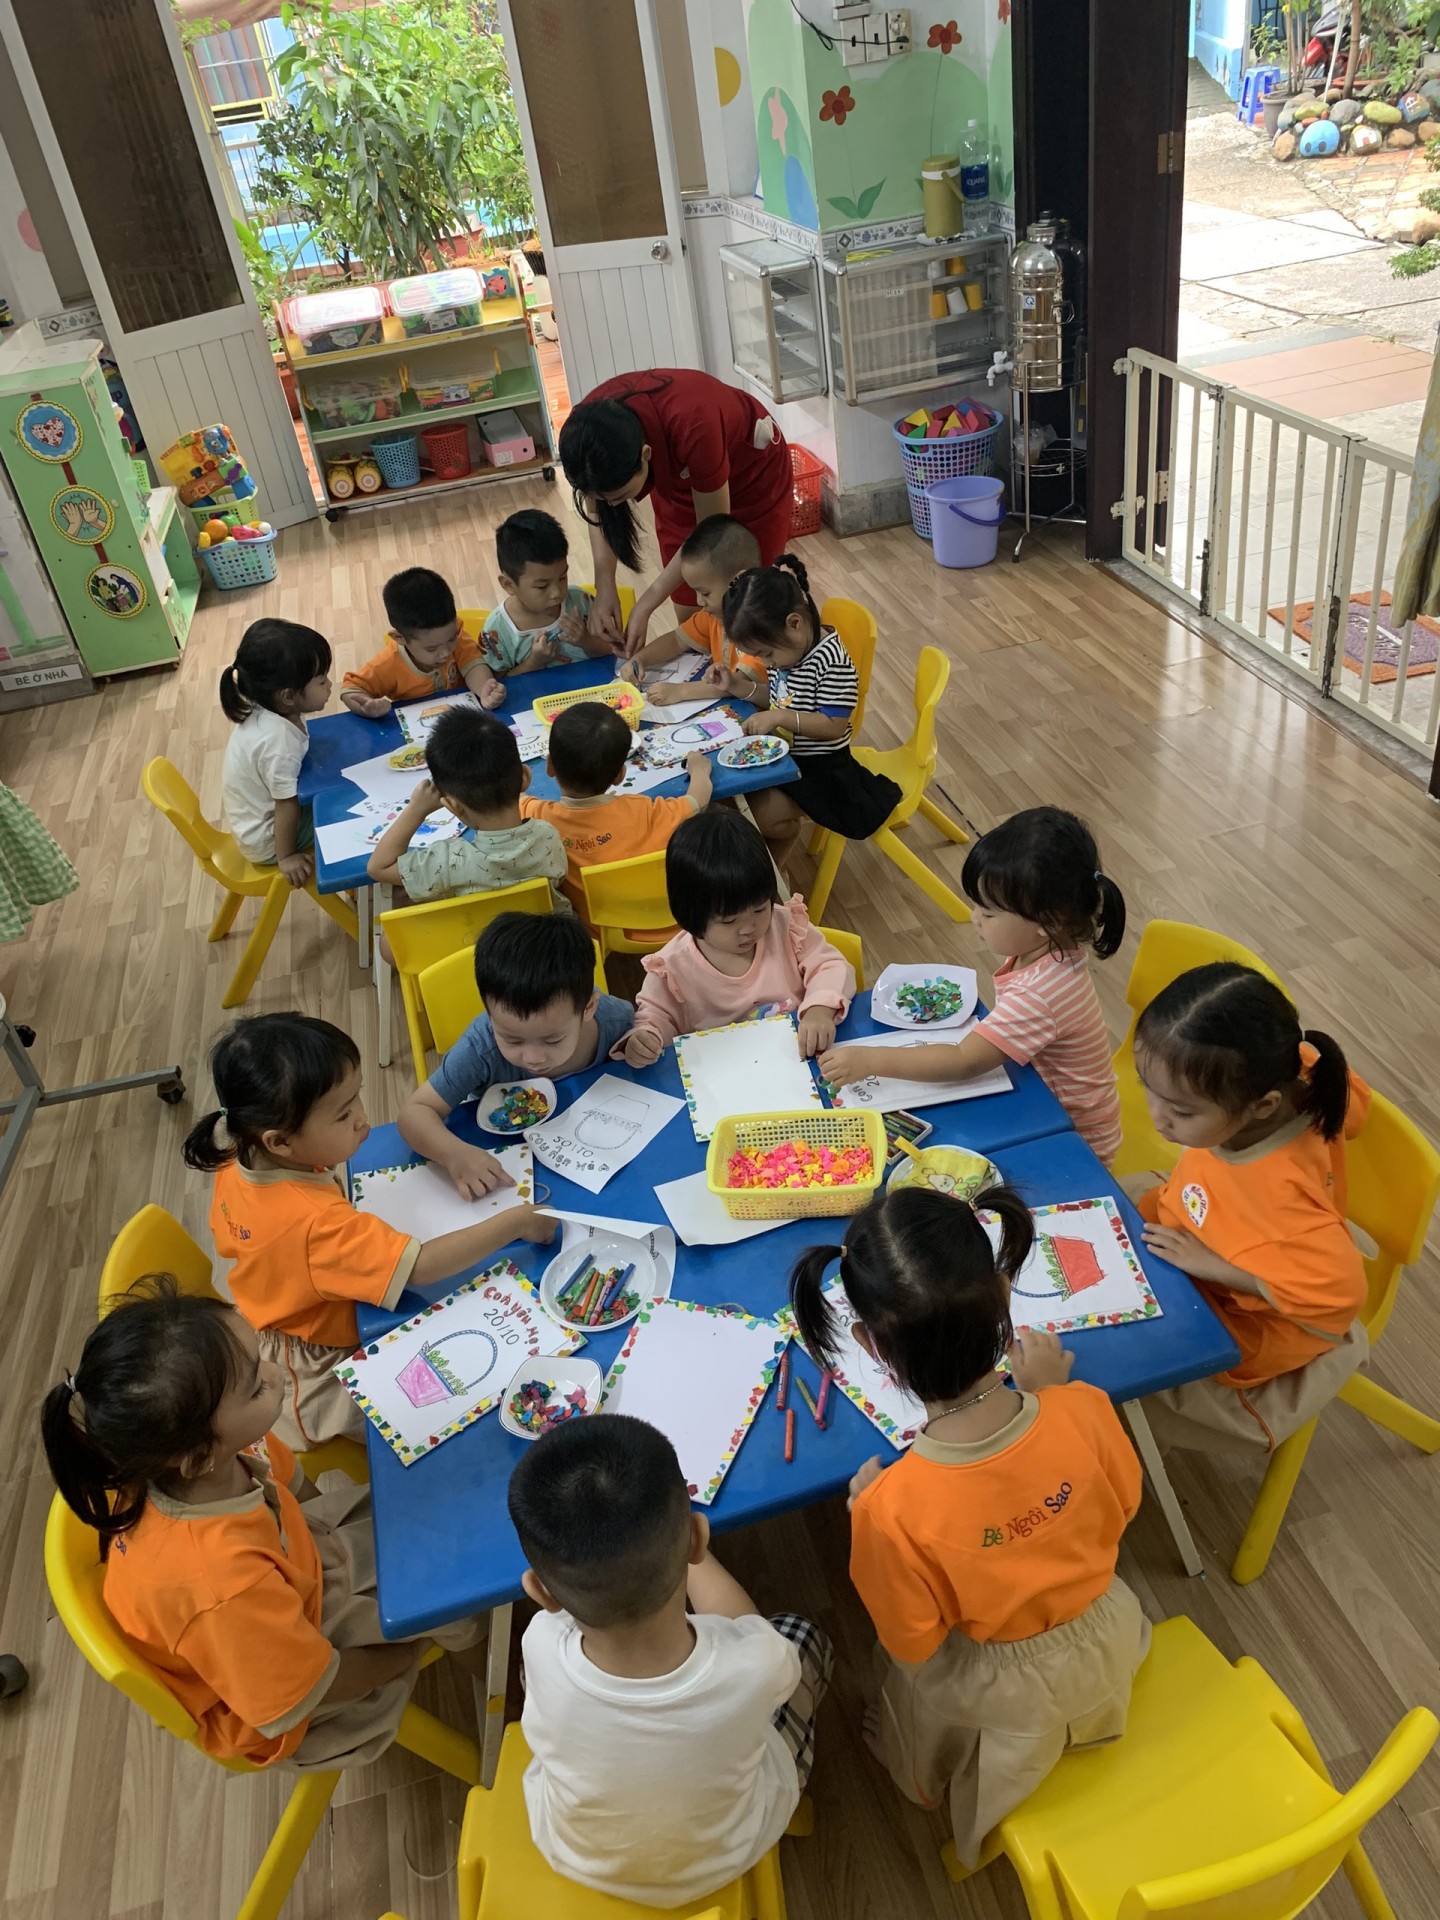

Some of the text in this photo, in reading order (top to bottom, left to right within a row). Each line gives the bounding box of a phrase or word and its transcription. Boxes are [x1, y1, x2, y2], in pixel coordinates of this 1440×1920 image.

[15, 675, 31, 686] BÉ
[44, 669, 69, 681] NHÀ
[595, 832, 613, 846] Sao
[483, 1286, 512, 1307] Con
[504, 1302, 533, 1325] yêu
[483, 1308, 520, 1346] 20/10
[981, 1481, 1073, 1548] Bé Ngôi Sao
